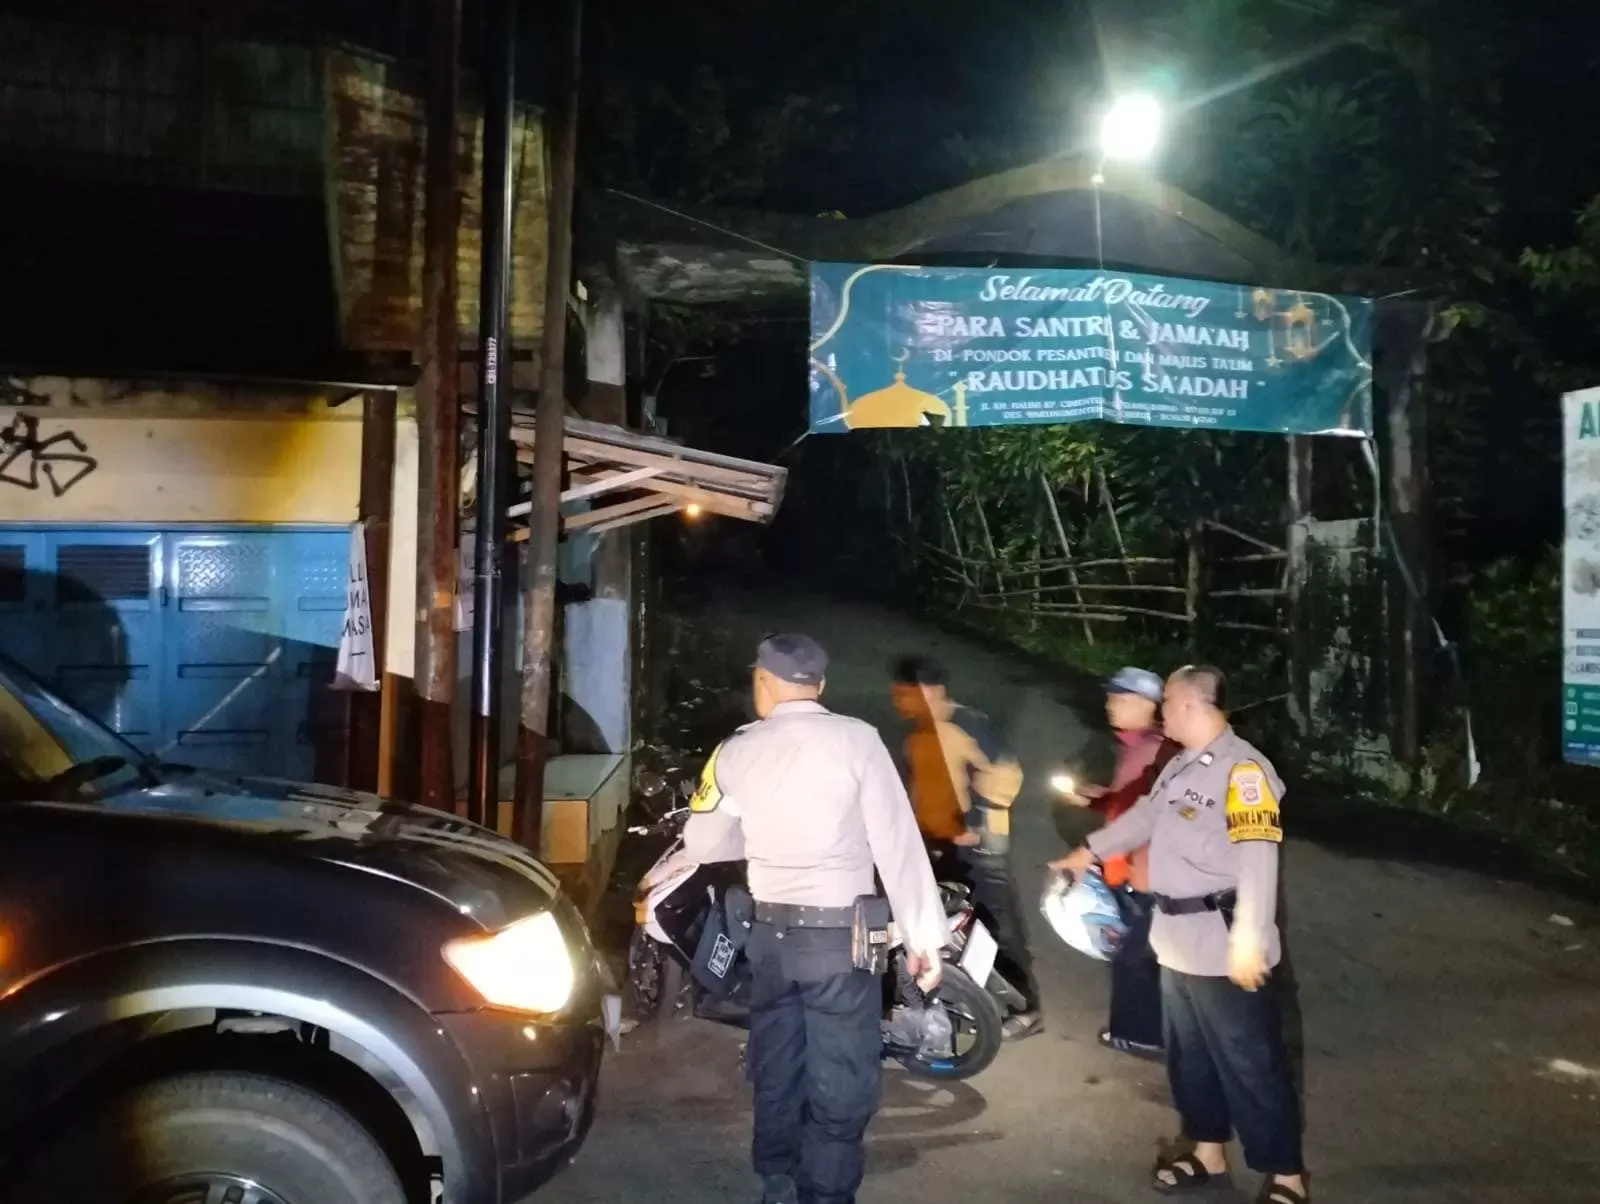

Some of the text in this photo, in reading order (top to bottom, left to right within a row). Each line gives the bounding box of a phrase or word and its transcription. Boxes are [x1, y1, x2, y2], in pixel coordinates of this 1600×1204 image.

[979, 274, 1211, 318] Selamat Datang
[935, 314, 1006, 338] PARA
[1014, 316, 1112, 338] SANTRI
[1118, 319, 1141, 340] &
[963, 348, 1033, 363] PONDOK
[968, 366, 1249, 399] RAUDHATUS SA'ADAH
[1579, 401, 1600, 440] A
